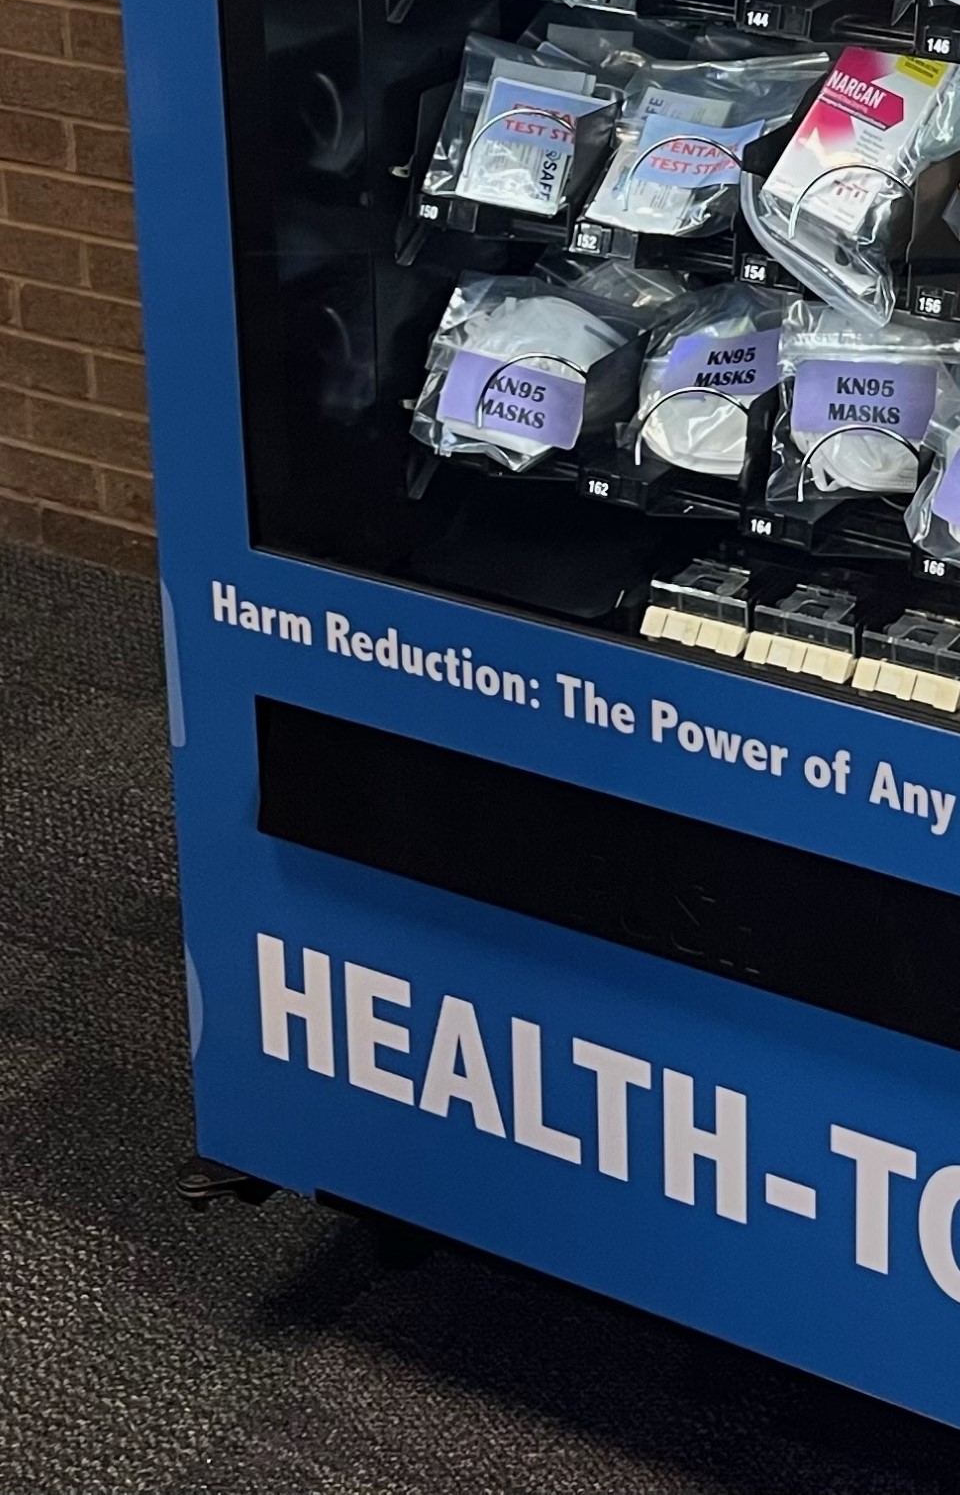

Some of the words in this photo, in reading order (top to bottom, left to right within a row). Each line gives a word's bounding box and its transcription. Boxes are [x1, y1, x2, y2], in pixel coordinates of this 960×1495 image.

[747, 11, 768, 27] 144
[927, 39, 950, 54] 146
[827, 70, 886, 109] NARCAN
[505, 120, 546, 136] TEST
[649, 156, 687, 174] TEST
[419, 206, 438, 220] 150
[576, 234, 597, 249] 152
[744, 265, 765, 280] 154
[919, 298, 941, 313] 156
[707, 348, 756, 365] KN95
[694, 369, 756, 388] MASKS
[489, 375, 546, 402] KN95
[836, 377, 895, 397] KN95
[478, 399, 545, 429] MASKS
[828, 403, 900, 424] MASKS
[589, 481, 608, 496] 162
[751, 520, 771, 535] 164
[923, 561, 945, 576] 166
[212, 581, 312, 646] Harm
[326, 611, 540, 709] Reduction:
[556, 674, 635, 734] The
[651, 699, 788, 777] Power
[804, 750, 850, 794] of
[869, 762, 956, 835] Any
